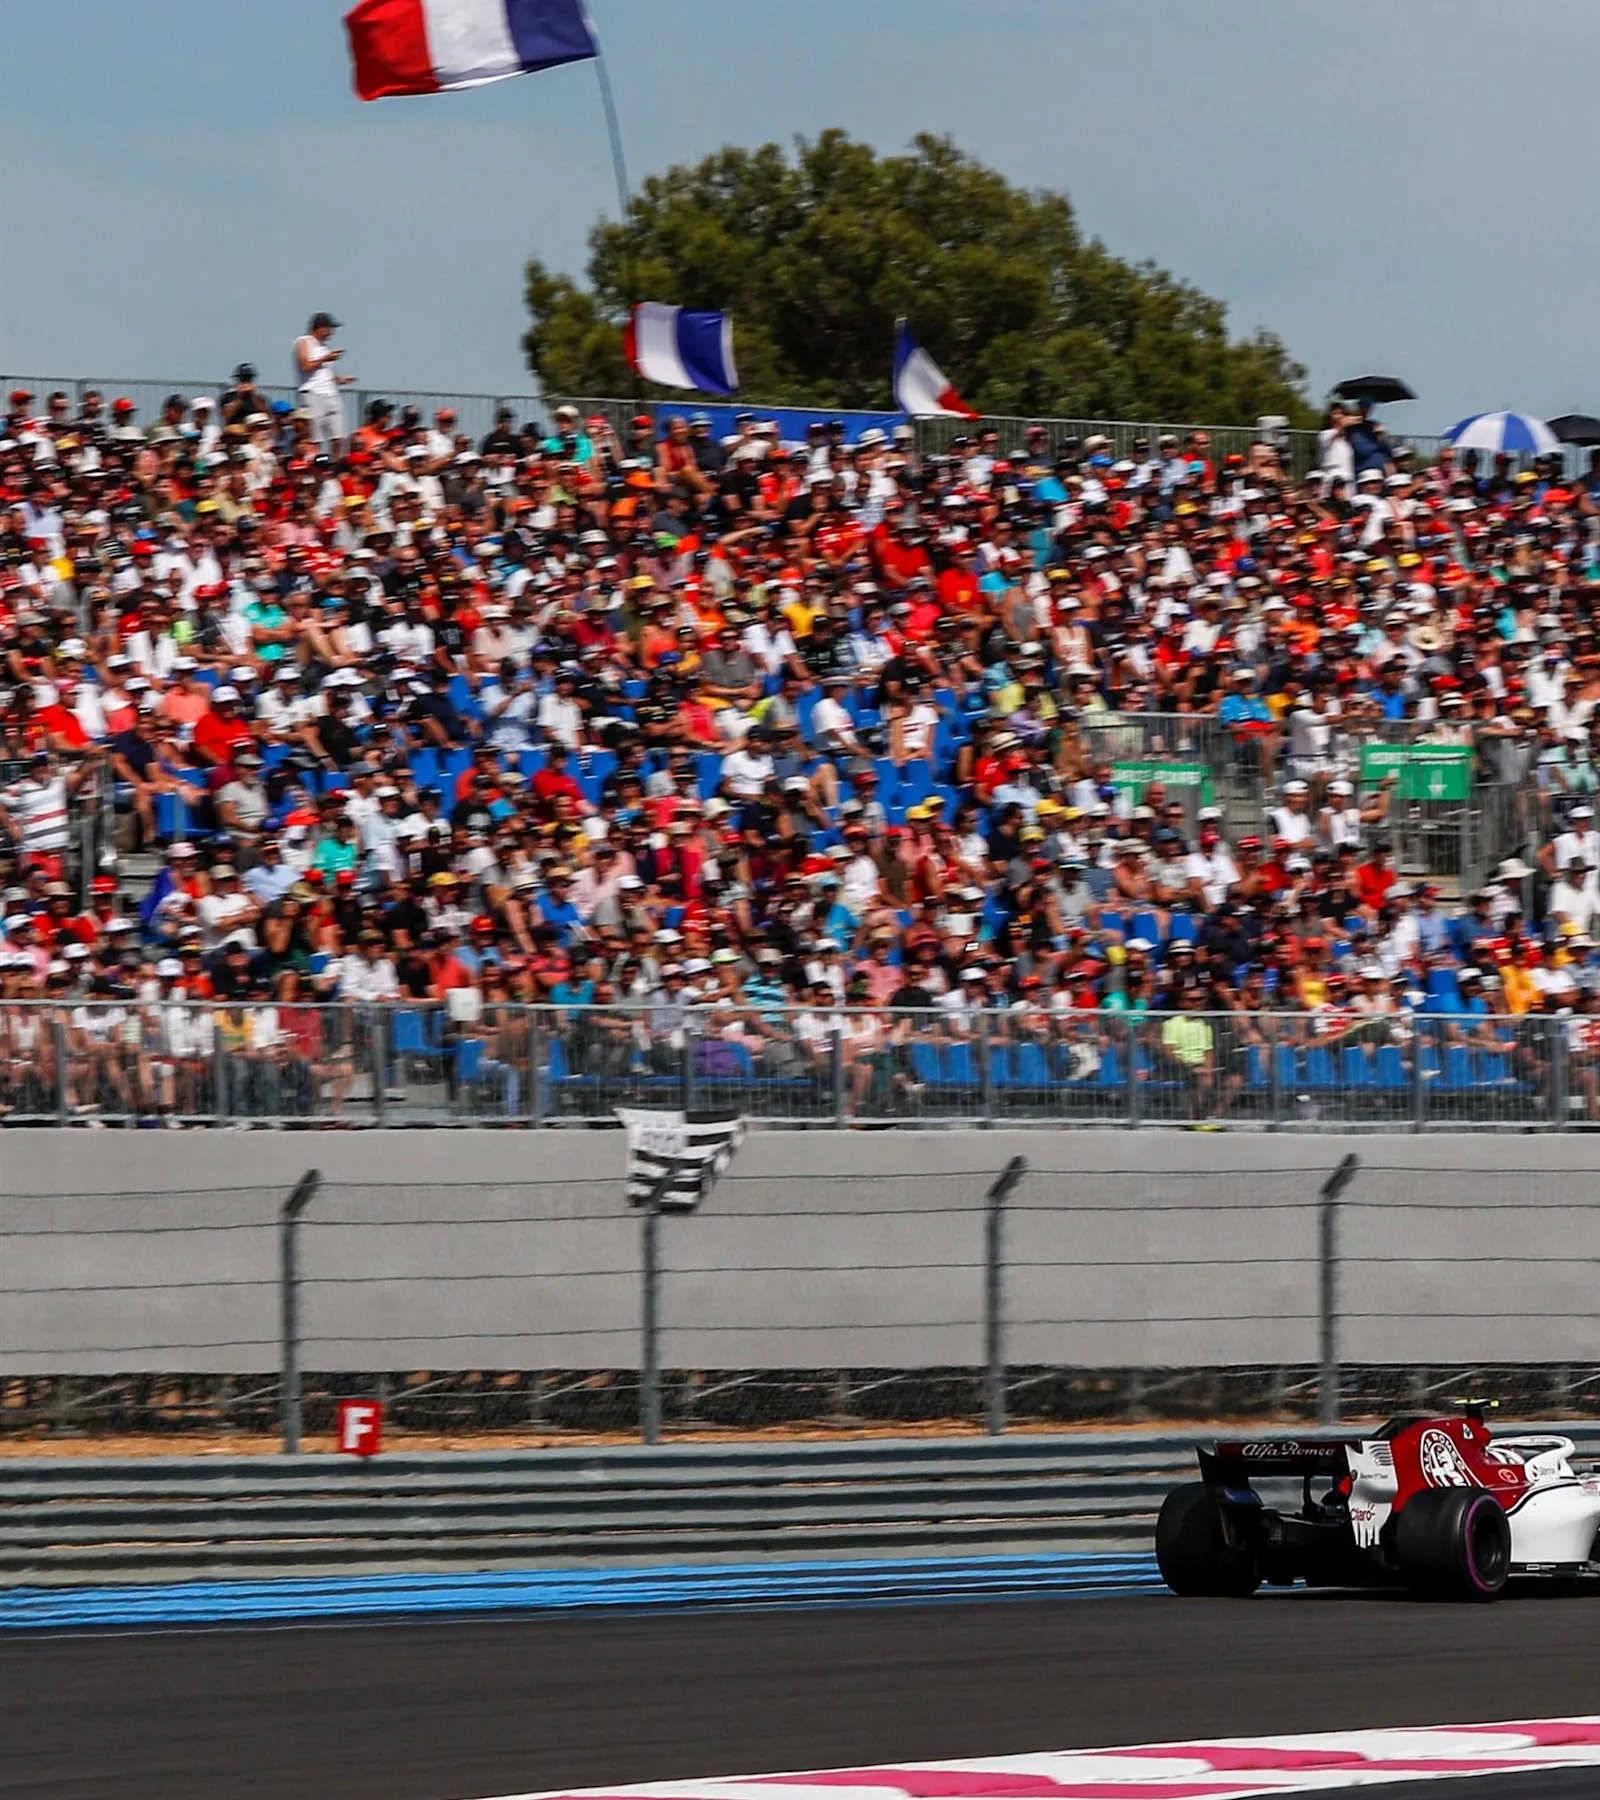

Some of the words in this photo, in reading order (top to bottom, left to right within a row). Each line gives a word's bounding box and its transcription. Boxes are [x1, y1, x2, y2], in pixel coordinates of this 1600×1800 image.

[343, 1406, 375, 1449] F
[1242, 1443, 1280, 1459] Alfa
[1281, 1441, 1336, 1456] Romeo
